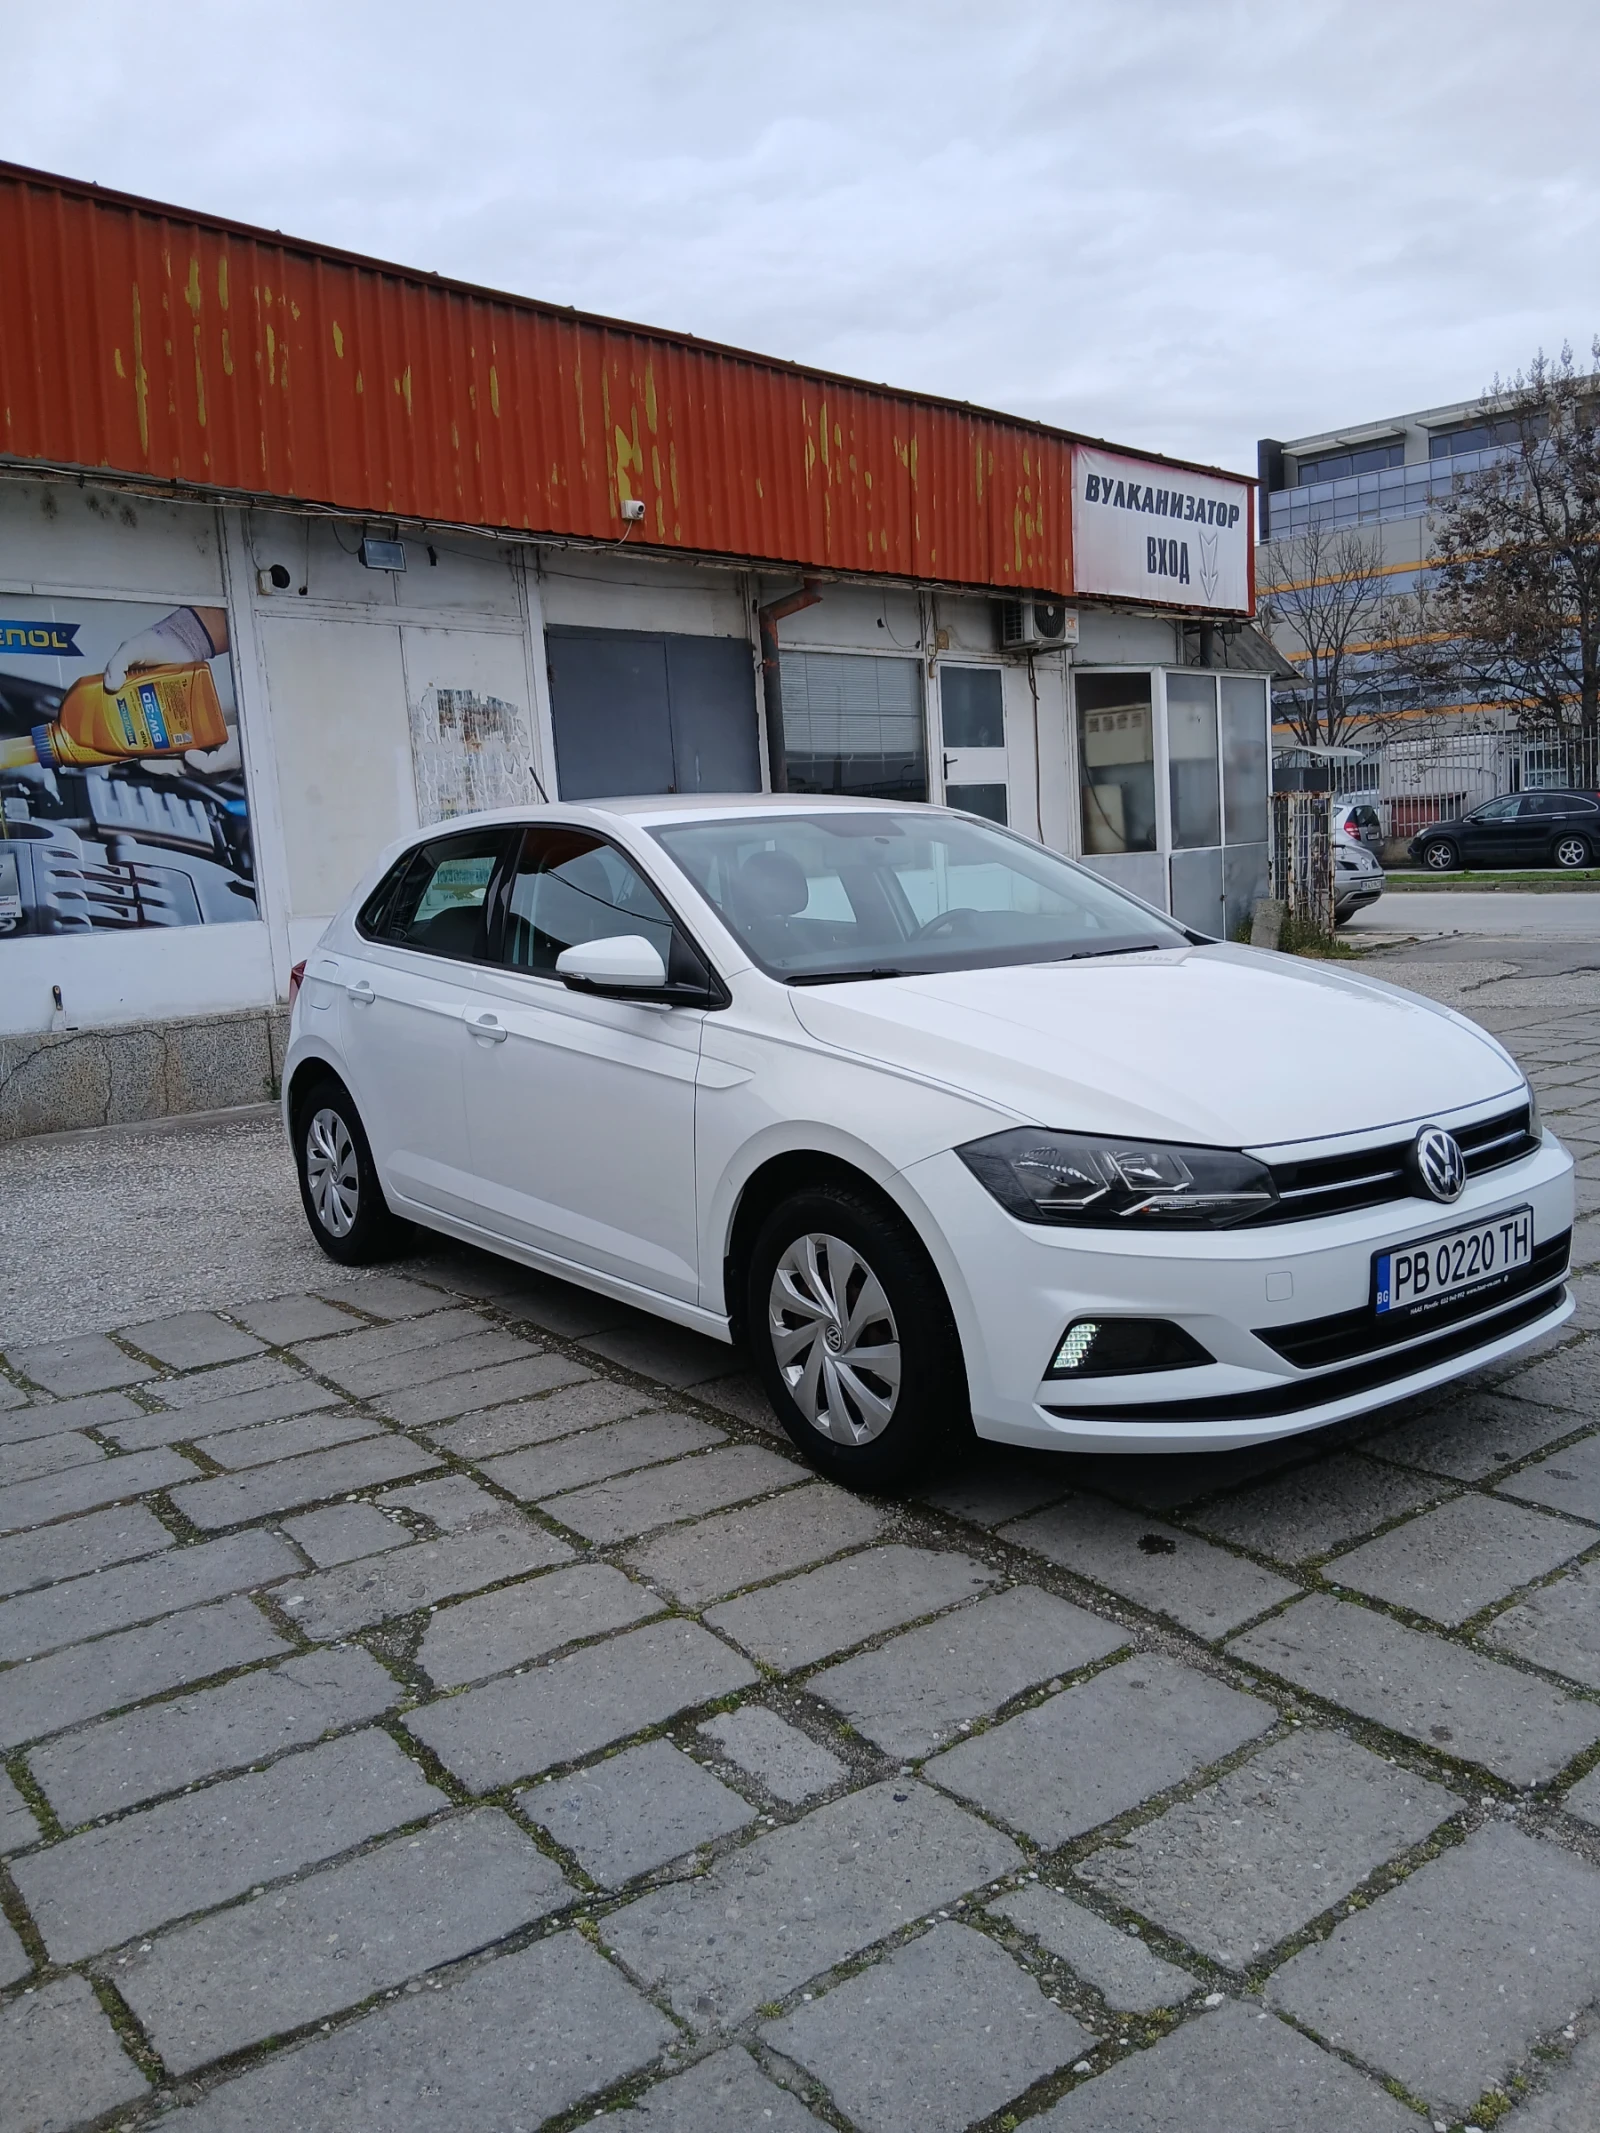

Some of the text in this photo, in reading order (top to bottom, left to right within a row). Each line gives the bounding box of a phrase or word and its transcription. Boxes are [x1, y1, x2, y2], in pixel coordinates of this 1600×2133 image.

[1085, 473, 1240, 529] ВУЛКАНИЗАТОР
[1147, 536, 1190, 585] ВХОД
[142, 692, 163, 743] 5W-30
[1395, 1217, 1528, 1301] PB 0220 TH
[1376, 1290, 1389, 1305] BG
